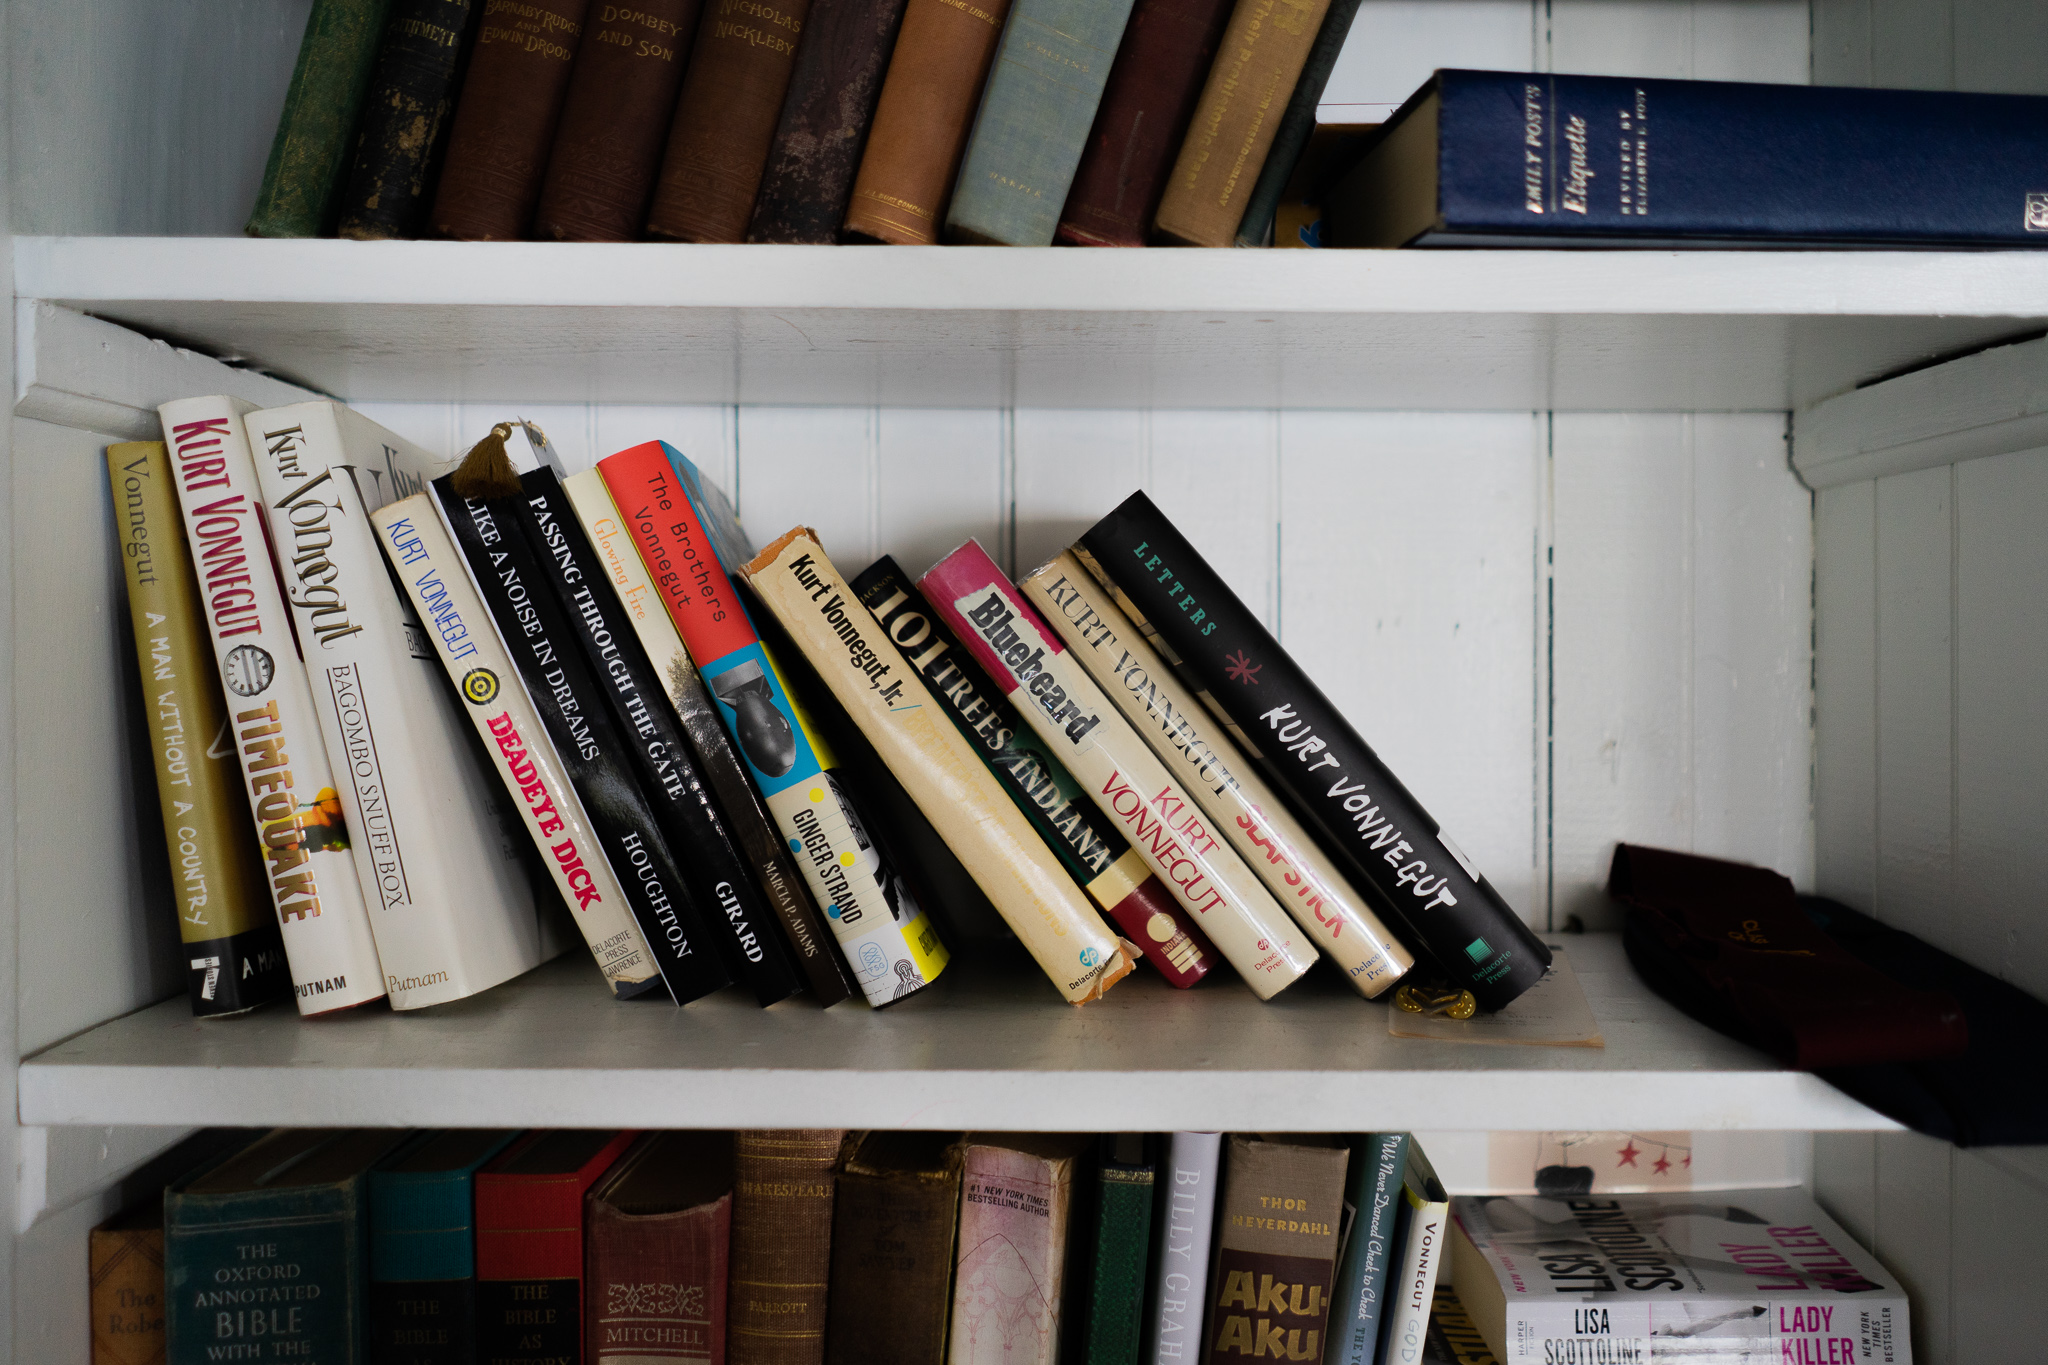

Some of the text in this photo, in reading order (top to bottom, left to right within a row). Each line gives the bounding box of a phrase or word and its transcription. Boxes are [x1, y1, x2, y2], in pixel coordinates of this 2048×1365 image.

[484, 0, 543, 20] BARNABY
[543, 11, 583, 37] RUDGE
[515, 20, 541, 33] AND
[600, 5, 683, 37] DOMBEY
[719, 0, 801, 33] NICHOLAS
[480, 26, 525, 44] EDWIN
[525, 35, 572, 61] DROOD
[597, 30, 674, 62] AND SON
[715, 21, 795, 56] NICKLEBY
[1523, 83, 1543, 214] EMILY POST'S
[1562, 113, 1596, 214] Etiquette
[1619, 109, 1632, 215] REVISED BY
[1635, 87, 1648, 216] ELIZABETH POST
[263, 422, 308, 481] Kurt
[122, 453, 159, 587] Vonnegut
[172, 417, 262, 639] KURT VONNEGUT
[272, 464, 364, 649] Vonnegut
[635, 505, 692, 609] Vonnegut
[648, 471, 726, 622] The Brothers
[593, 518, 648, 620] Glowing Fire
[386, 517, 430, 566] KURT
[416, 569, 479, 660] VONNEGUT
[860, 574, 894, 605] JACKSON
[1133, 541, 1217, 636] LETTERS
[463, 496, 600, 762] LIKE A NOISE IN DREAMS
[788, 553, 904, 707] Kurt Vonnegut, Jr.
[528, 495, 686, 801] PASSING THROUGH THE GATE
[967, 592, 1101, 746] Bluebeard
[1043, 573, 1241, 800] KURT VONNEGUT
[931, 658, 1014, 751] TREES
[145, 611, 209, 926] A MAN WITHOUT A COUNTRY
[331, 664, 405, 909] BAGOMBO SNUFF BOX
[236, 699, 324, 924] TIMEQUAKE
[486, 711, 565, 838] DEADEYE
[551, 838, 602, 912] DICK
[1008, 753, 1111, 875] INDIANA
[1150, 785, 1221, 859] KURT
[1259, 703, 1458, 910] KURT VONNEGUT
[1101, 769, 1227, 915] VONNEGUT
[792, 808, 863, 925] GINGER STRAND
[621, 830, 693, 959] HOUGHTON
[763, 860, 819, 958] MARCIA P. ADAMS
[715, 880, 765, 963] GIRARD
[591, 930, 632, 955] DELACORTE
[604, 944, 629, 961] PRESS
[1160, 931, 1188, 955] INDIANA
[1350, 943, 1391, 977] Delacote
[242, 956, 255, 980] A
[388, 971, 449, 993] Putnam
[603, 953, 642, 978] LAWRENCE
[868, 962, 885, 973] FSG
[1068, 964, 1103, 990] Delacorte
[1366, 962, 1388, 981] Pres
[1472, 950, 1512, 981] Delacorte
[1486, 964, 1512, 985] Press
[295, 975, 347, 1000] PUTNAM
[737, 1181, 834, 1198] HAKESPEARE
[967, 1193, 1050, 1218] BESTSELLING AUTHOR
[970, 1184, 1049, 1207] #1 NEW YORK TIMES
[1260, 1196, 1307, 1212] THOR
[1232, 1214, 1331, 1236] HEYERDAHL
[1357, 1141, 1398, 1320] We Never Danced Cheek to Cheek
[237, 1243, 278, 1260] THE
[1159, 1167, 1201, 1365] BILLY GRAH
[1411, 1222, 1438, 1311] VONNEGUT
[1720, 1243, 1810, 1290] LADY
[1767, 1225, 1874, 1290] KILLER
[214, 1263, 301, 1284] OXFORD
[1538, 1254, 1618, 1293] LISA
[116, 1288, 156, 1308] The
[195, 1284, 321, 1308] ANNOTATED
[397, 1300, 441, 1316] THE
[510, 1284, 550, 1301] THE
[749, 1300, 807, 1314] PARROTT
[215, 1306, 302, 1339] BIBLE
[504, 1308, 558, 1326] BIBLE
[1574, 1308, 1611, 1334] LISA
[1779, 1306, 1834, 1333] LADY
[1860, 1311, 1872, 1358] NEW YORK
[1871, 1320, 1881, 1348] TIMES
[206, 1339, 312, 1361] WITH THE
[393, 1329, 449, 1345] BIBLE
[518, 1334, 543, 1350] AS
[606, 1327, 704, 1345] MITCHELL
[1215, 1315, 1320, 1361] Aku
[1353, 1327, 1366, 1351] THE
[1401, 1319, 1420, 1362] GOD
[1517, 1320, 1525, 1356] HARPER
[1544, 1338, 1644, 1365] SCOTTOLINE
[1780, 1337, 1855, 1365] KILLER
[1882, 1307, 1894, 1363] BESTSELLER
